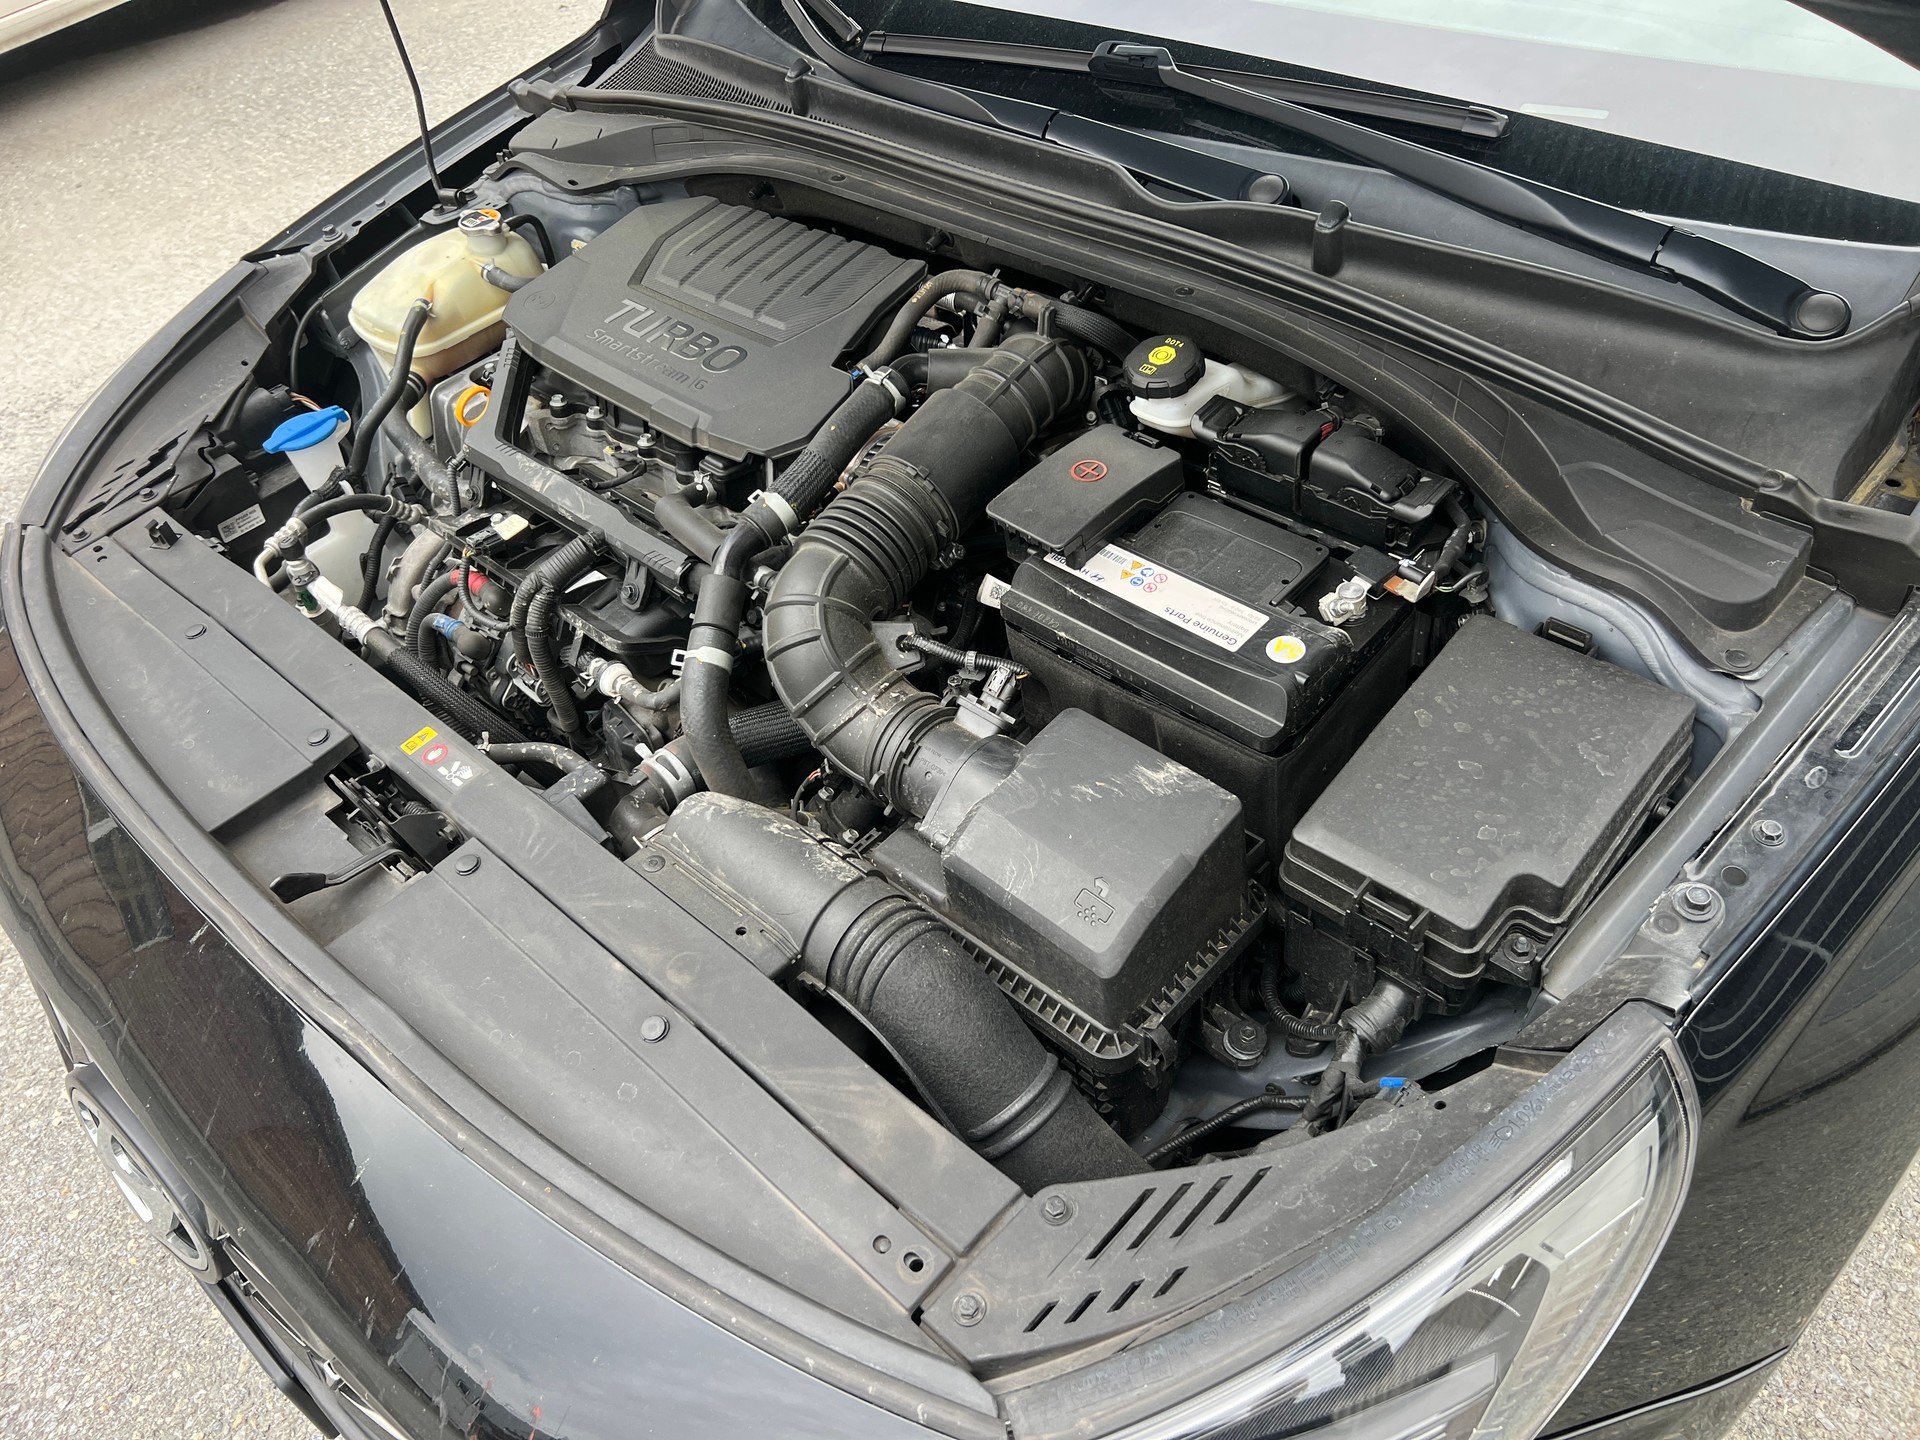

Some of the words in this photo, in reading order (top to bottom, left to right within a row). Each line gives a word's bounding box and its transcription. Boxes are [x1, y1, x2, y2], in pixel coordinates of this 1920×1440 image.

[604, 298, 748, 373] TURBO
[1164, 337, 1185, 348] DOT4
[586, 328, 690, 384] Smartstream
[1164, 606, 1193, 624] Parts
[1193, 620, 1238, 646] Genuine
